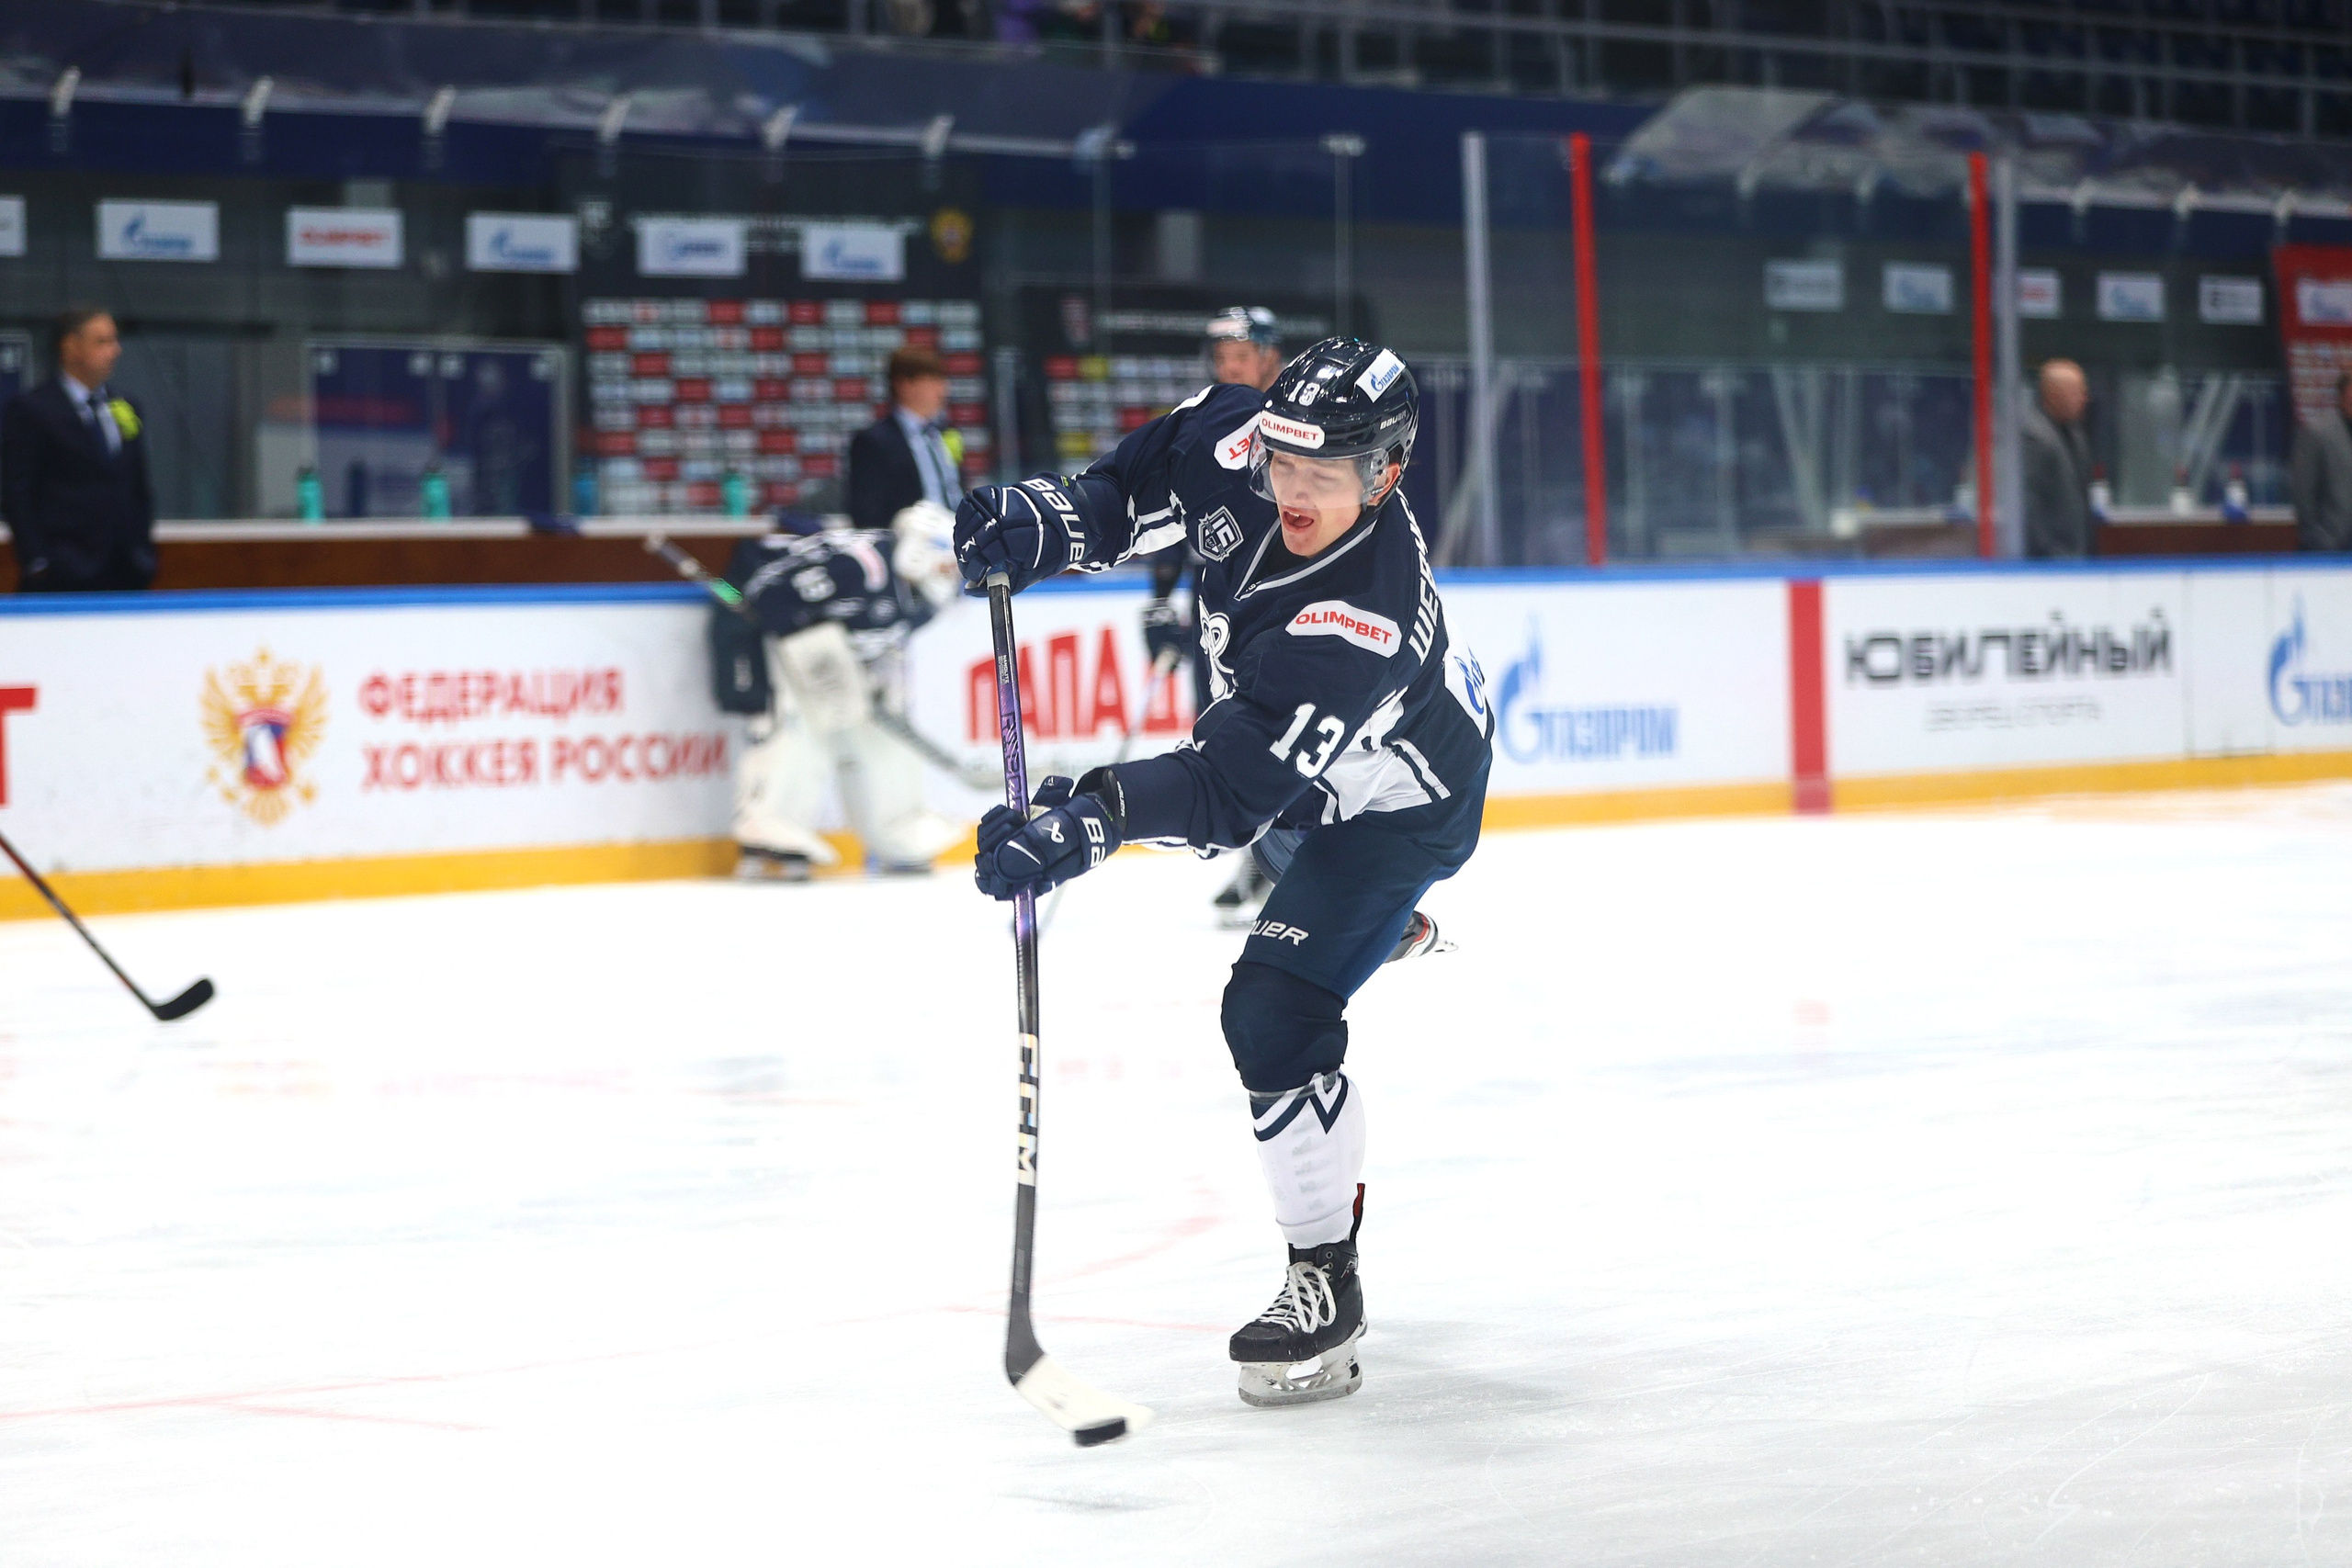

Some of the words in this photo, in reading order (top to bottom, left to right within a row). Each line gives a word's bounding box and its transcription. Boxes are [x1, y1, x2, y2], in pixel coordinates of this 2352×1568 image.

[1288, 379, 1320, 406] 13
[1261, 418, 1319, 441] OLIMPBET
[1022, 478, 1085, 561] BAUE
[1295, 611, 1393, 645] OLIMPBET
[1844, 608, 2173, 687] ЮБИЛЕЙНЫЙ
[357, 669, 624, 728] ФЕДЕРАЦИЯ
[362, 737, 538, 789] ХОККЕЯ
[552, 733, 729, 784] РОССИИ
[1269, 702, 1345, 779] 13
[1250, 919, 1309, 946] UER
[1017, 1032, 1040, 1187] CCM
